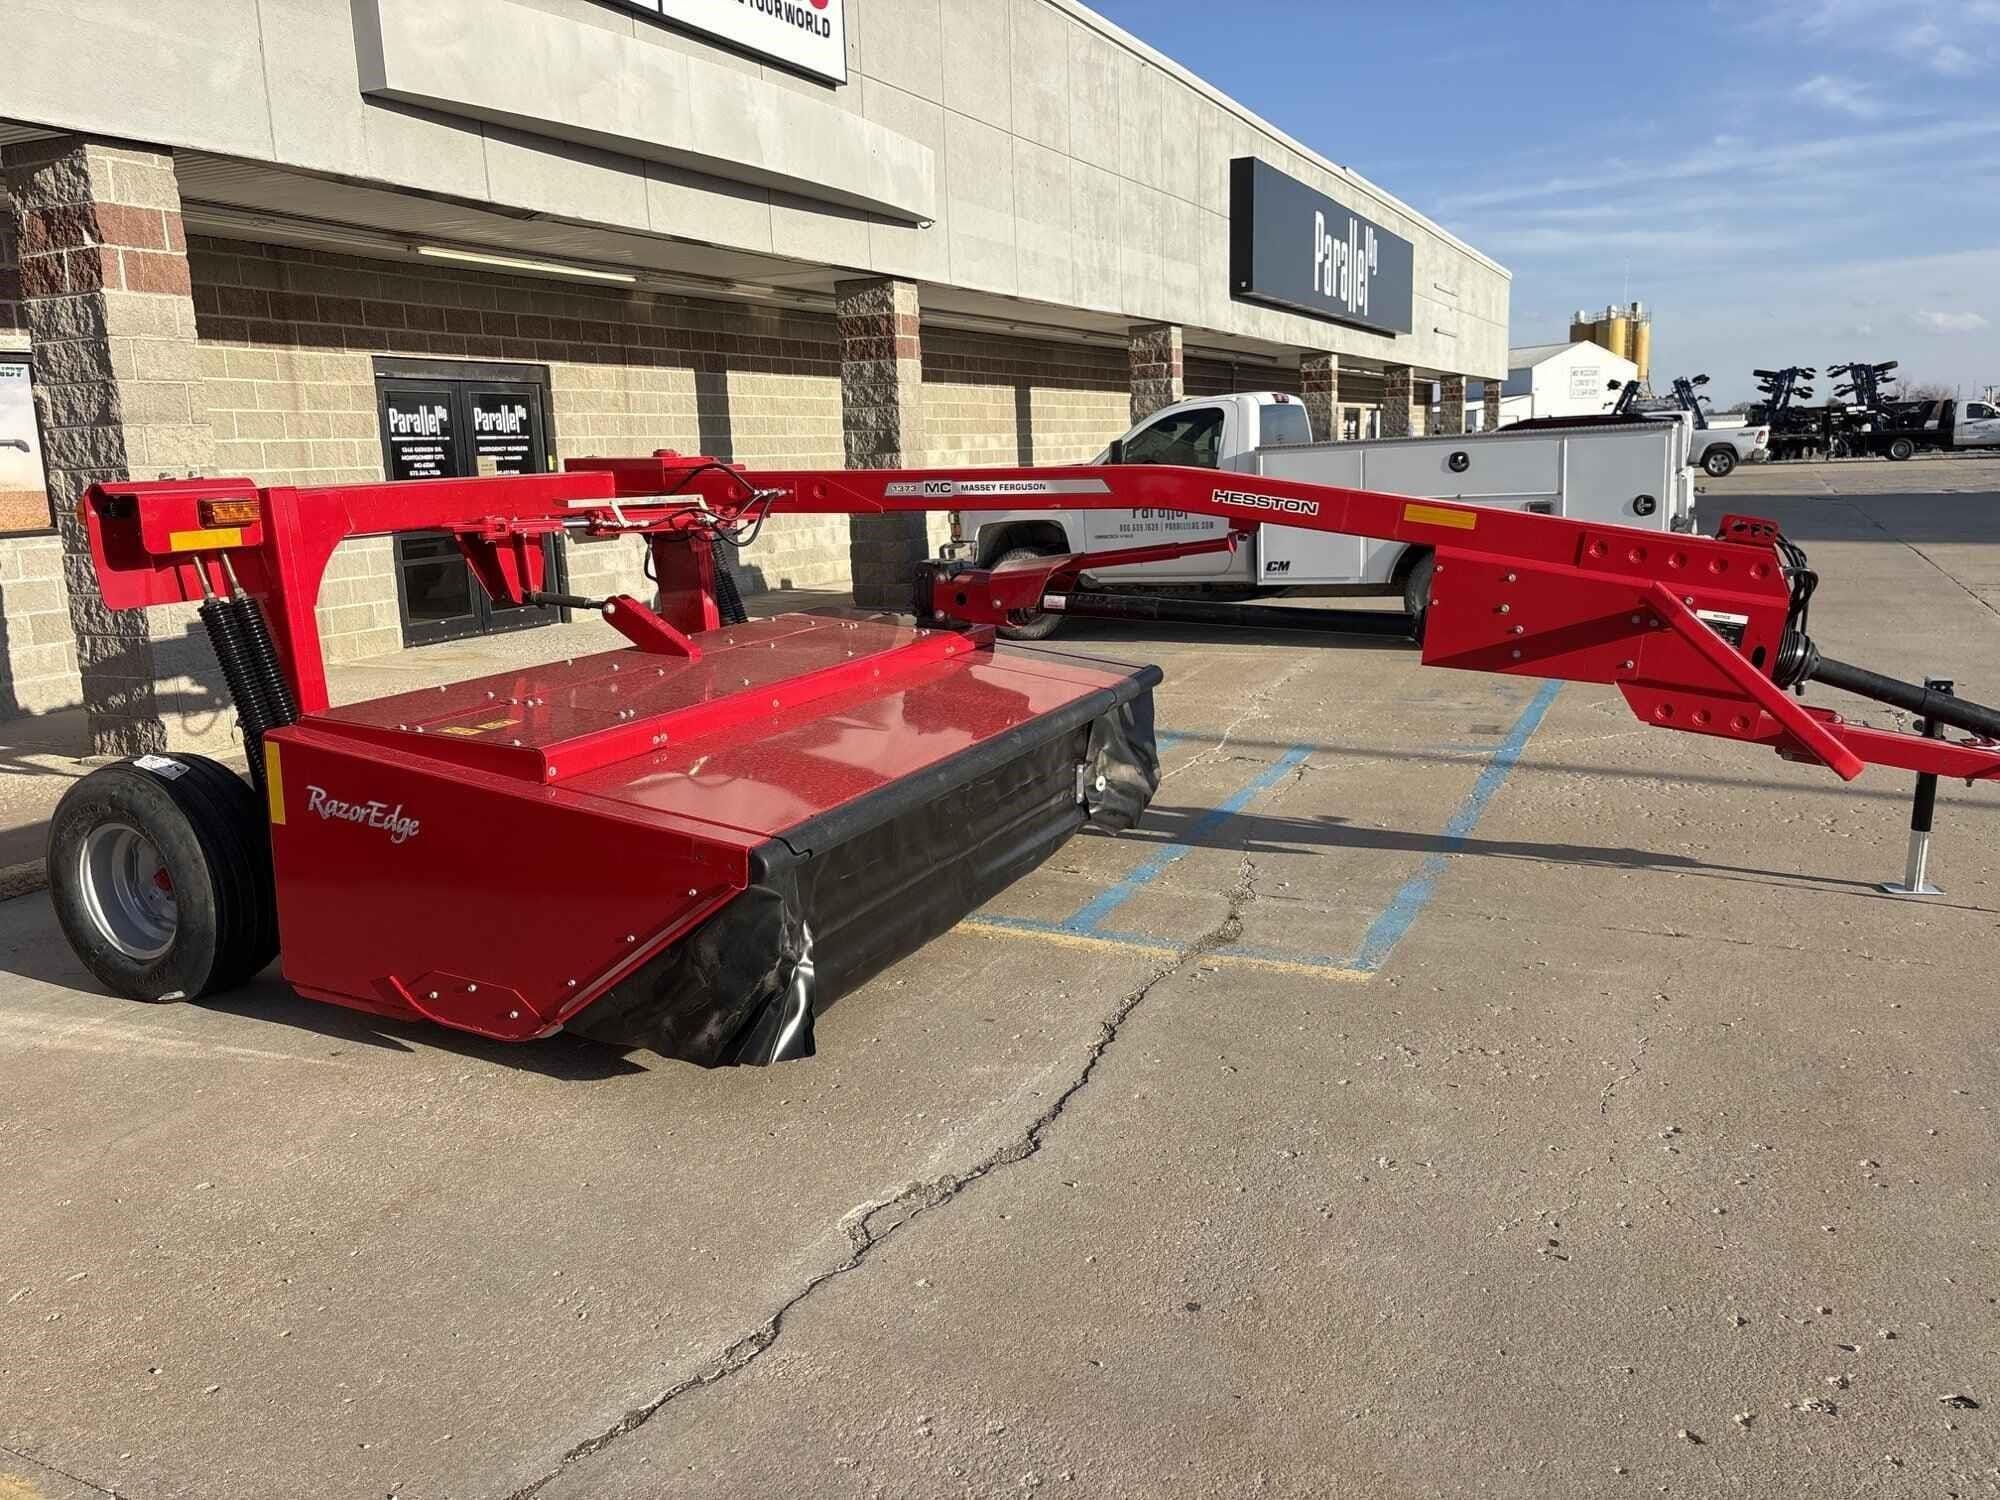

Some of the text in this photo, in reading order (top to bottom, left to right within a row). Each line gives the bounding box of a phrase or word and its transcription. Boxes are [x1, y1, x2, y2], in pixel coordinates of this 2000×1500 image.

[784, 2, 830, 38] WORLD
[925, 482, 951, 493] MC
[960, 483, 996, 492] MASSEY
[999, 482, 1047, 491] FERGUSON
[1212, 490, 1319, 515] HESSTON
[1266, 560, 1290, 572] CM
[306, 785, 420, 843] RazorEdge
